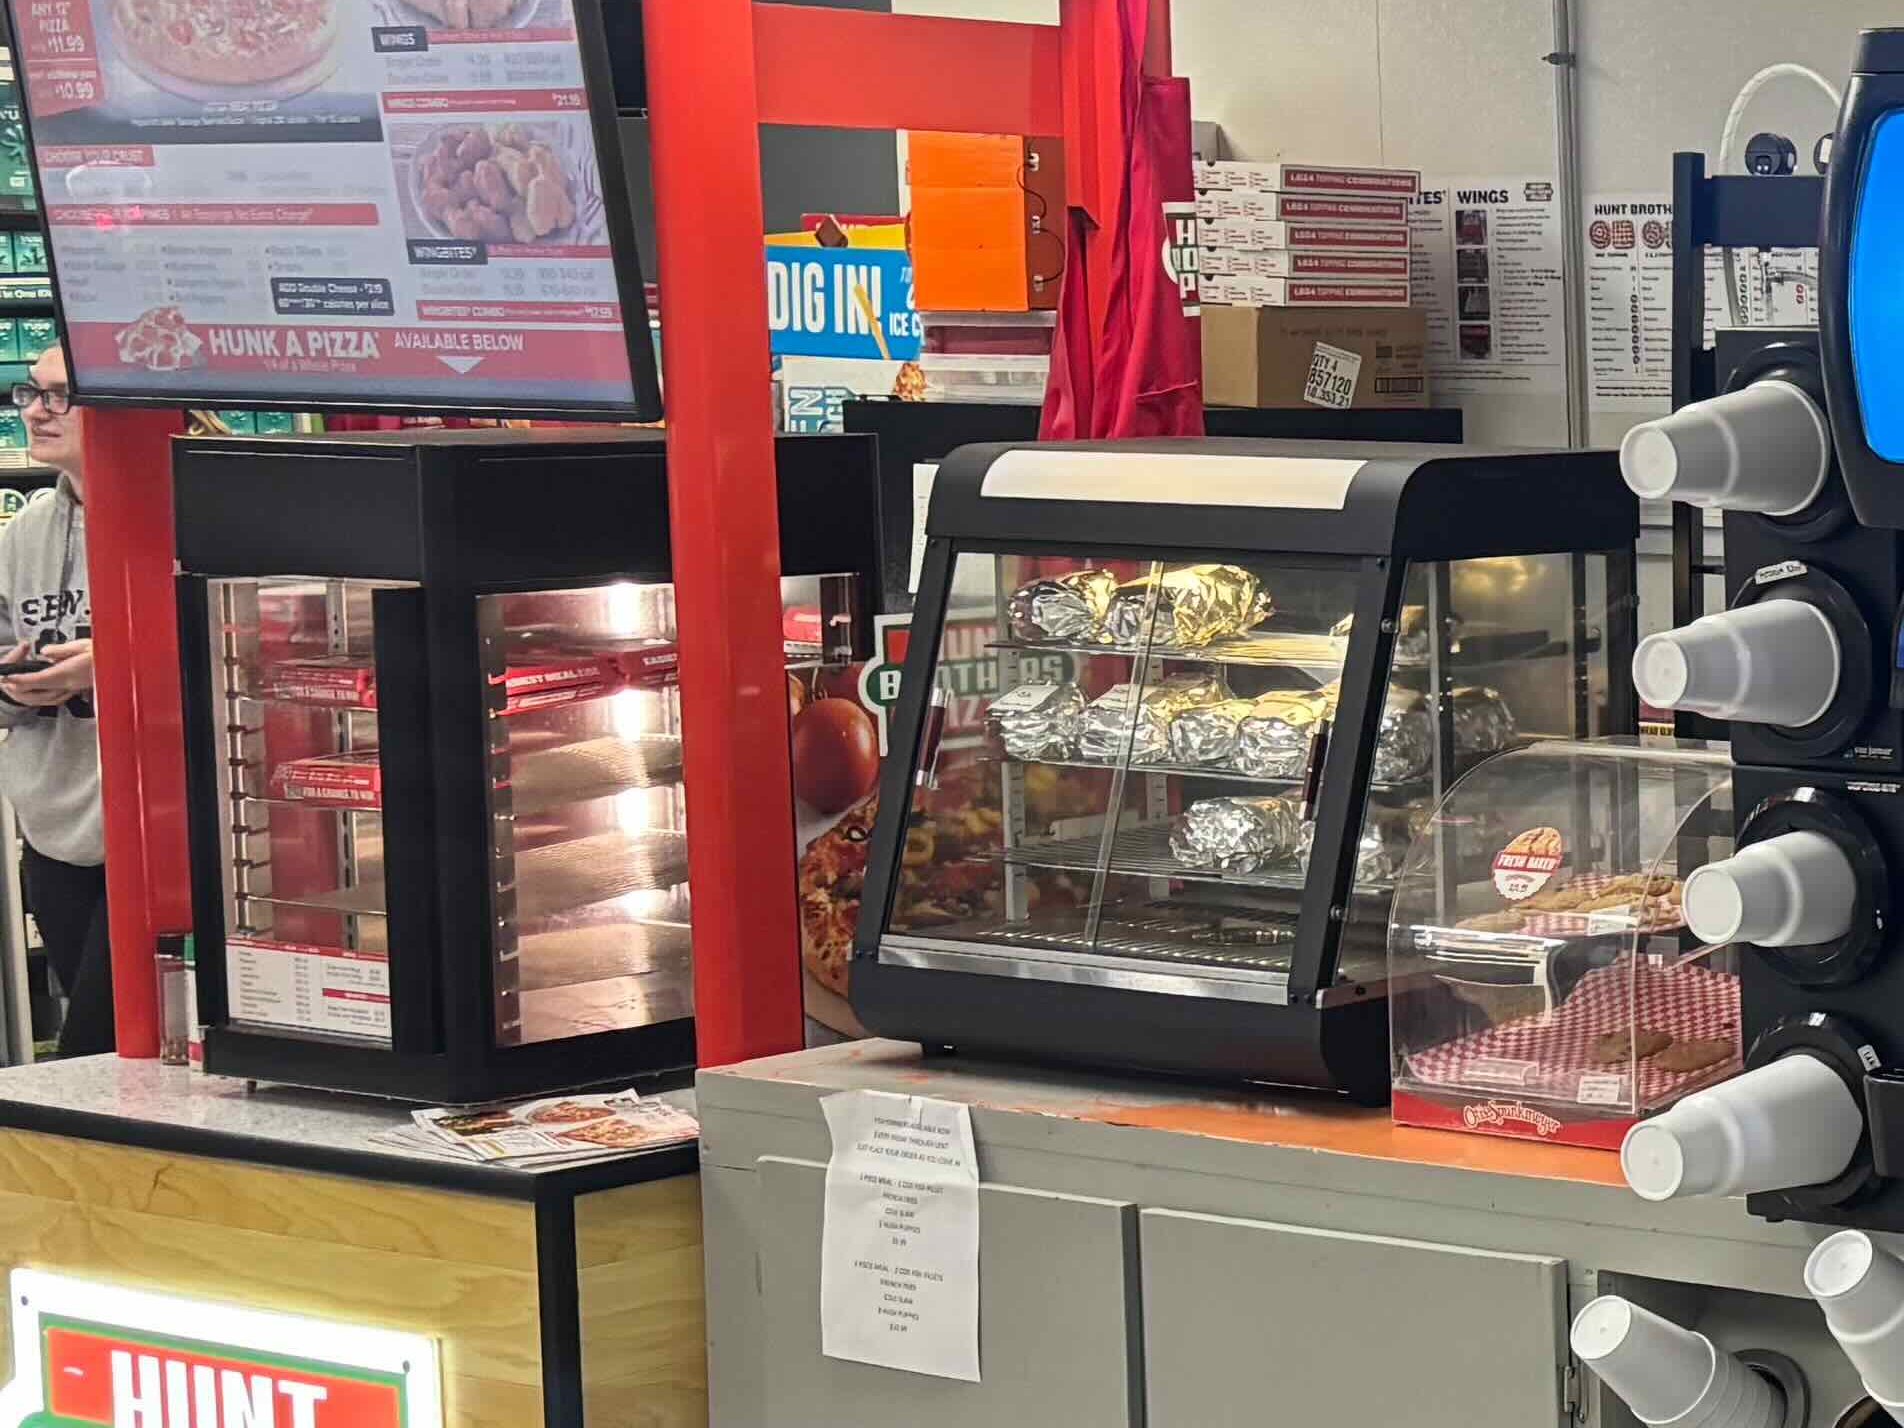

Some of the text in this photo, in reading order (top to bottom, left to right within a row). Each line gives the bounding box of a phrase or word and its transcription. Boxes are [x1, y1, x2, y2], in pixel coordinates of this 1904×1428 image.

[1457, 190, 1509, 204] WINGS
[1594, 204, 1628, 216] HUNT
[767, 261, 825, 333] DIG
[889, 312, 910, 337] ICE
[210, 328, 283, 358] HUNK
[286, 329, 304, 358] A
[395, 332, 471, 350] AVAILABLE
[473, 333, 525, 351] BELOW
[1312, 353, 1329, 369] QTY
[1497, 853, 1528, 868] FRESH
